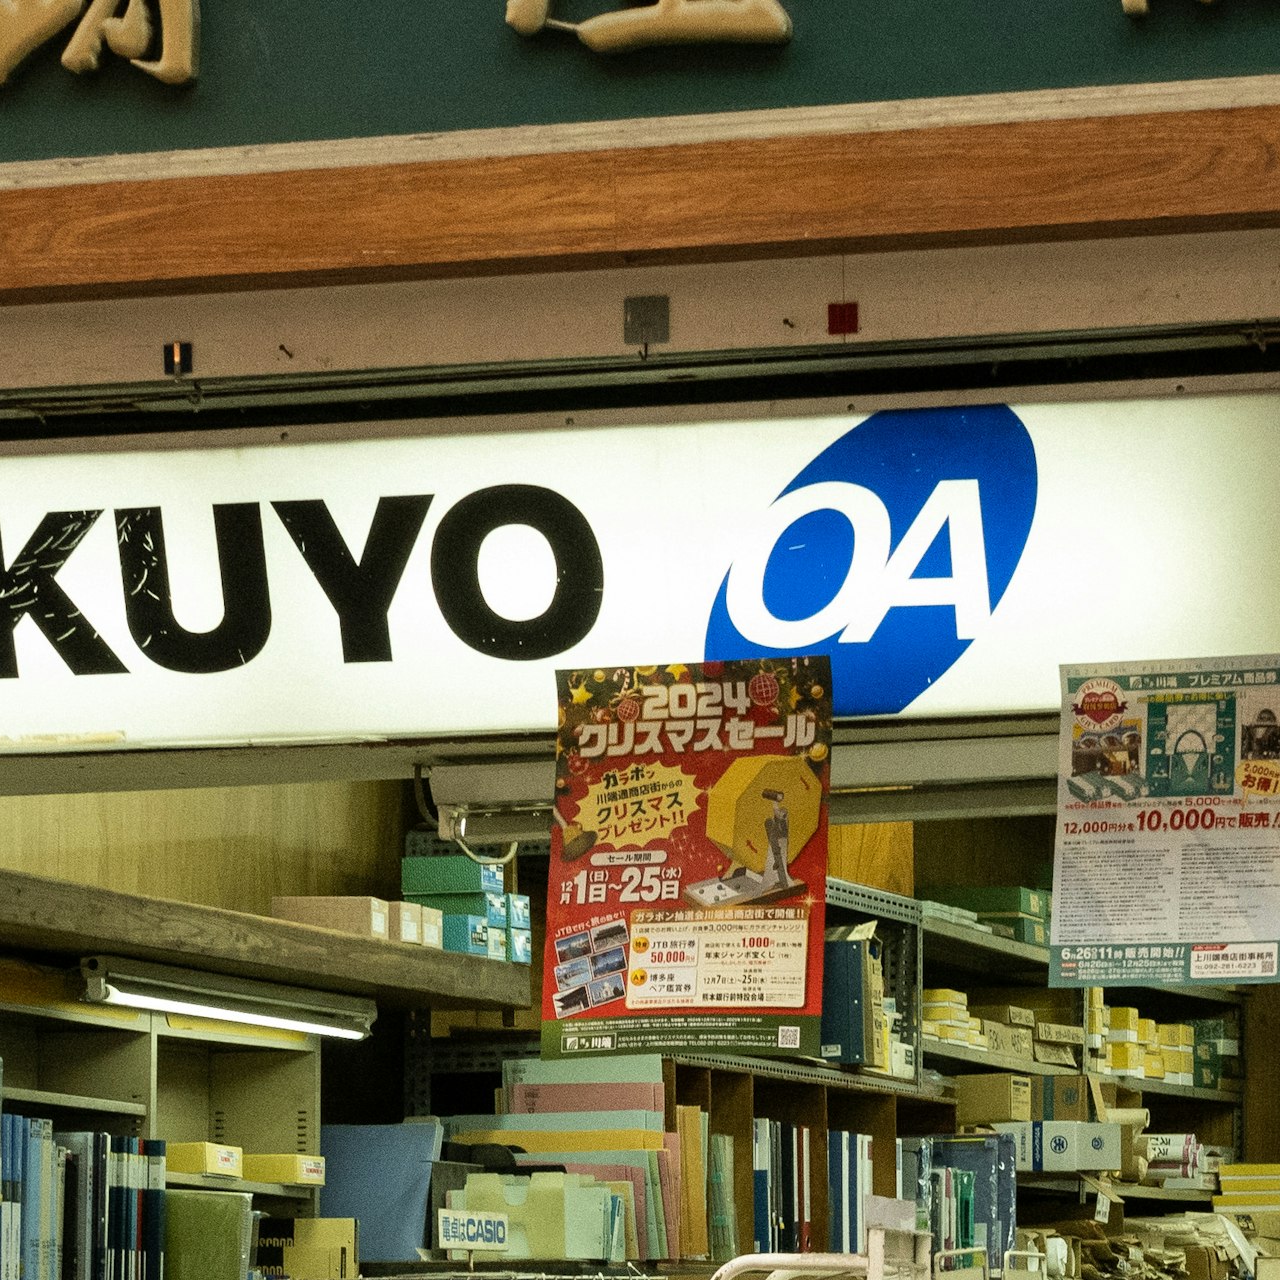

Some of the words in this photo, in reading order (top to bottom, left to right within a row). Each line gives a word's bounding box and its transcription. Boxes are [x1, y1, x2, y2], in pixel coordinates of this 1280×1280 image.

[725, 478, 995, 650] OA
[642, 683, 750, 719] 2024
[579, 715, 815, 757] クリスマスセール
[603, 764, 655, 790] ガラポン
[597, 792, 683, 824] クリスマス
[606, 852, 651, 863] セール期間
[705, 950, 775, 959] 年末ジャンボ宝くじ
[650, 973, 675, 982] 博多座
[442, 1216, 506, 1244] 電卓はCASIO
